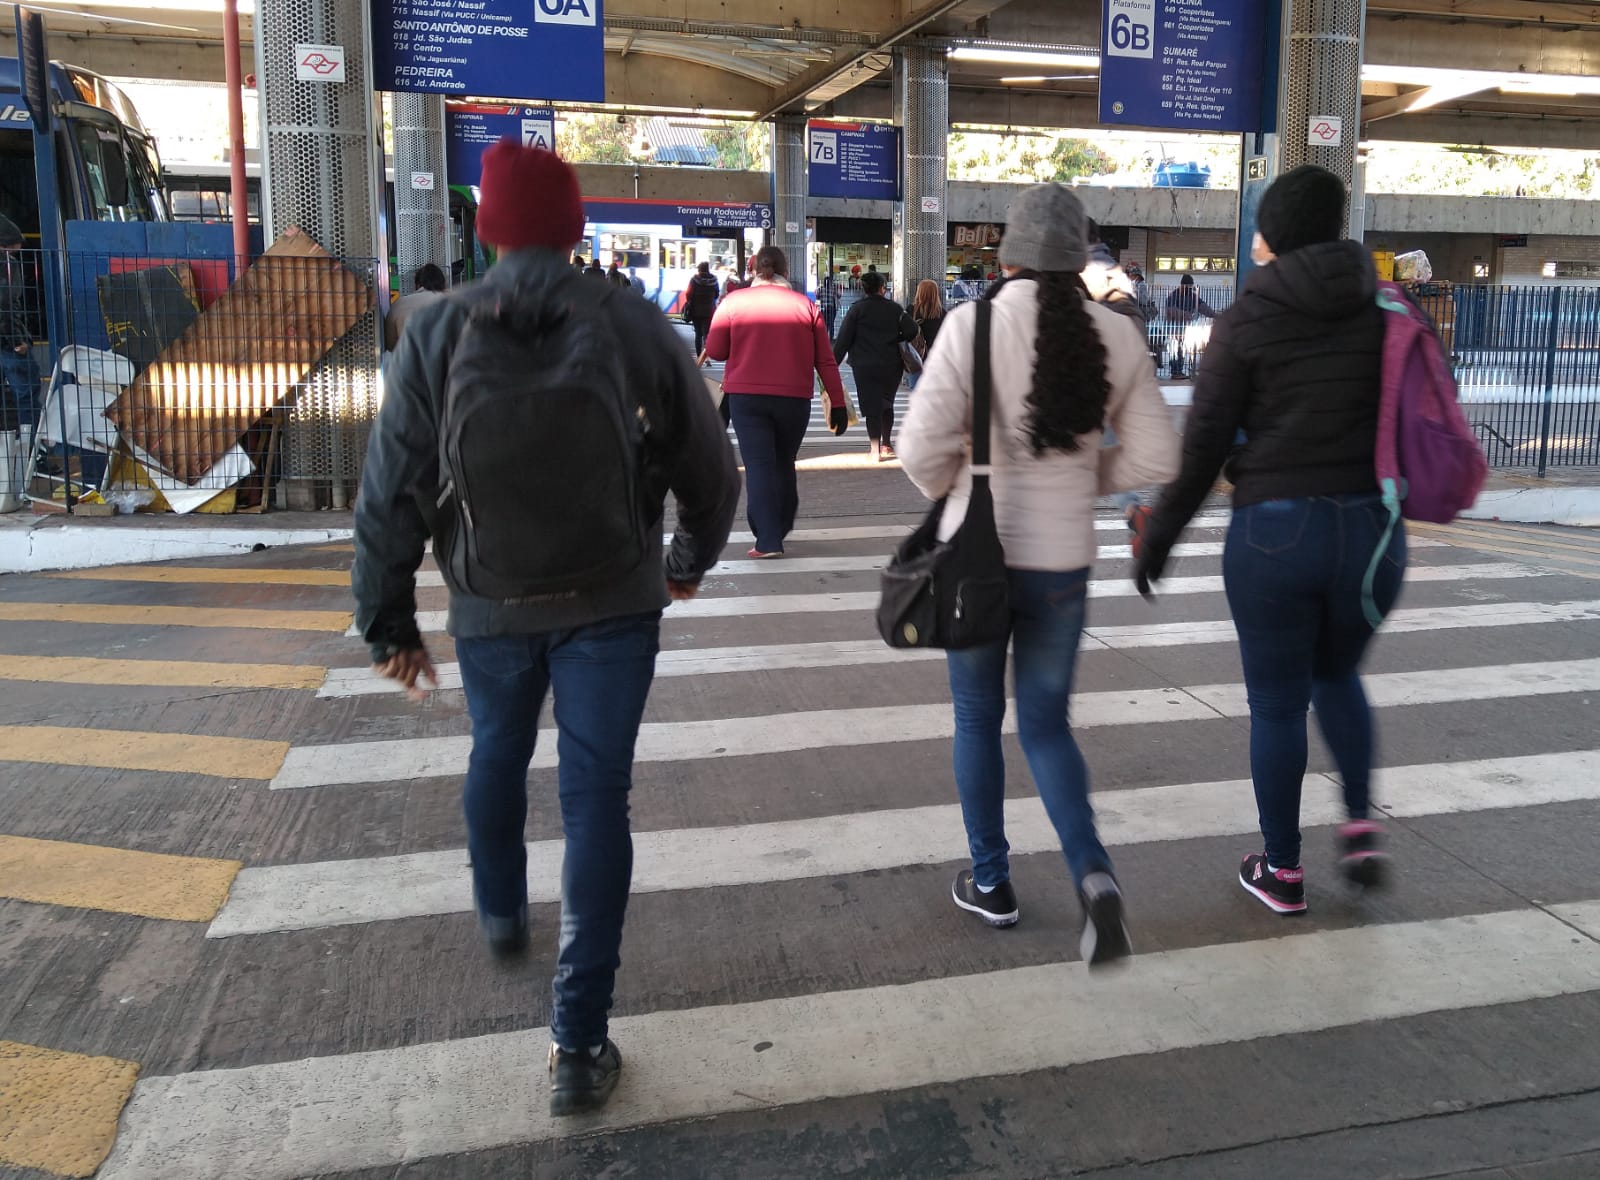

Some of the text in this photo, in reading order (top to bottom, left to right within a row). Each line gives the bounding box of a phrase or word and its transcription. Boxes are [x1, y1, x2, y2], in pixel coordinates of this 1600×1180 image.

[458, 1, 486, 10] Nassif
[1113, 0, 1151, 10] Plataforma
[392, 6, 408, 14] 715
[412, 8, 440, 16] Nassif
[481, 13, 512, 22] Unicamp)
[393, 20, 528, 37] SANTO ANTÔNIO DE POSSE
[1111, 13, 1150, 50] 6B
[428, 34, 445, 43] São
[446, 35, 472, 44] Judas
[394, 42, 442, 52] 734 Centro
[1163, 46, 1198, 57] SUMARÉ
[395, 66, 453, 78] PEDREIRA
[414, 79, 427, 88] Jd.
[429, 80, 466, 89] Andrade
[525, 130, 548, 150] 7A
[813, 141, 834, 160] 7B
[677, 206, 757, 217] Terminal Rodoviário
[717, 218, 757, 228] Sanitários
